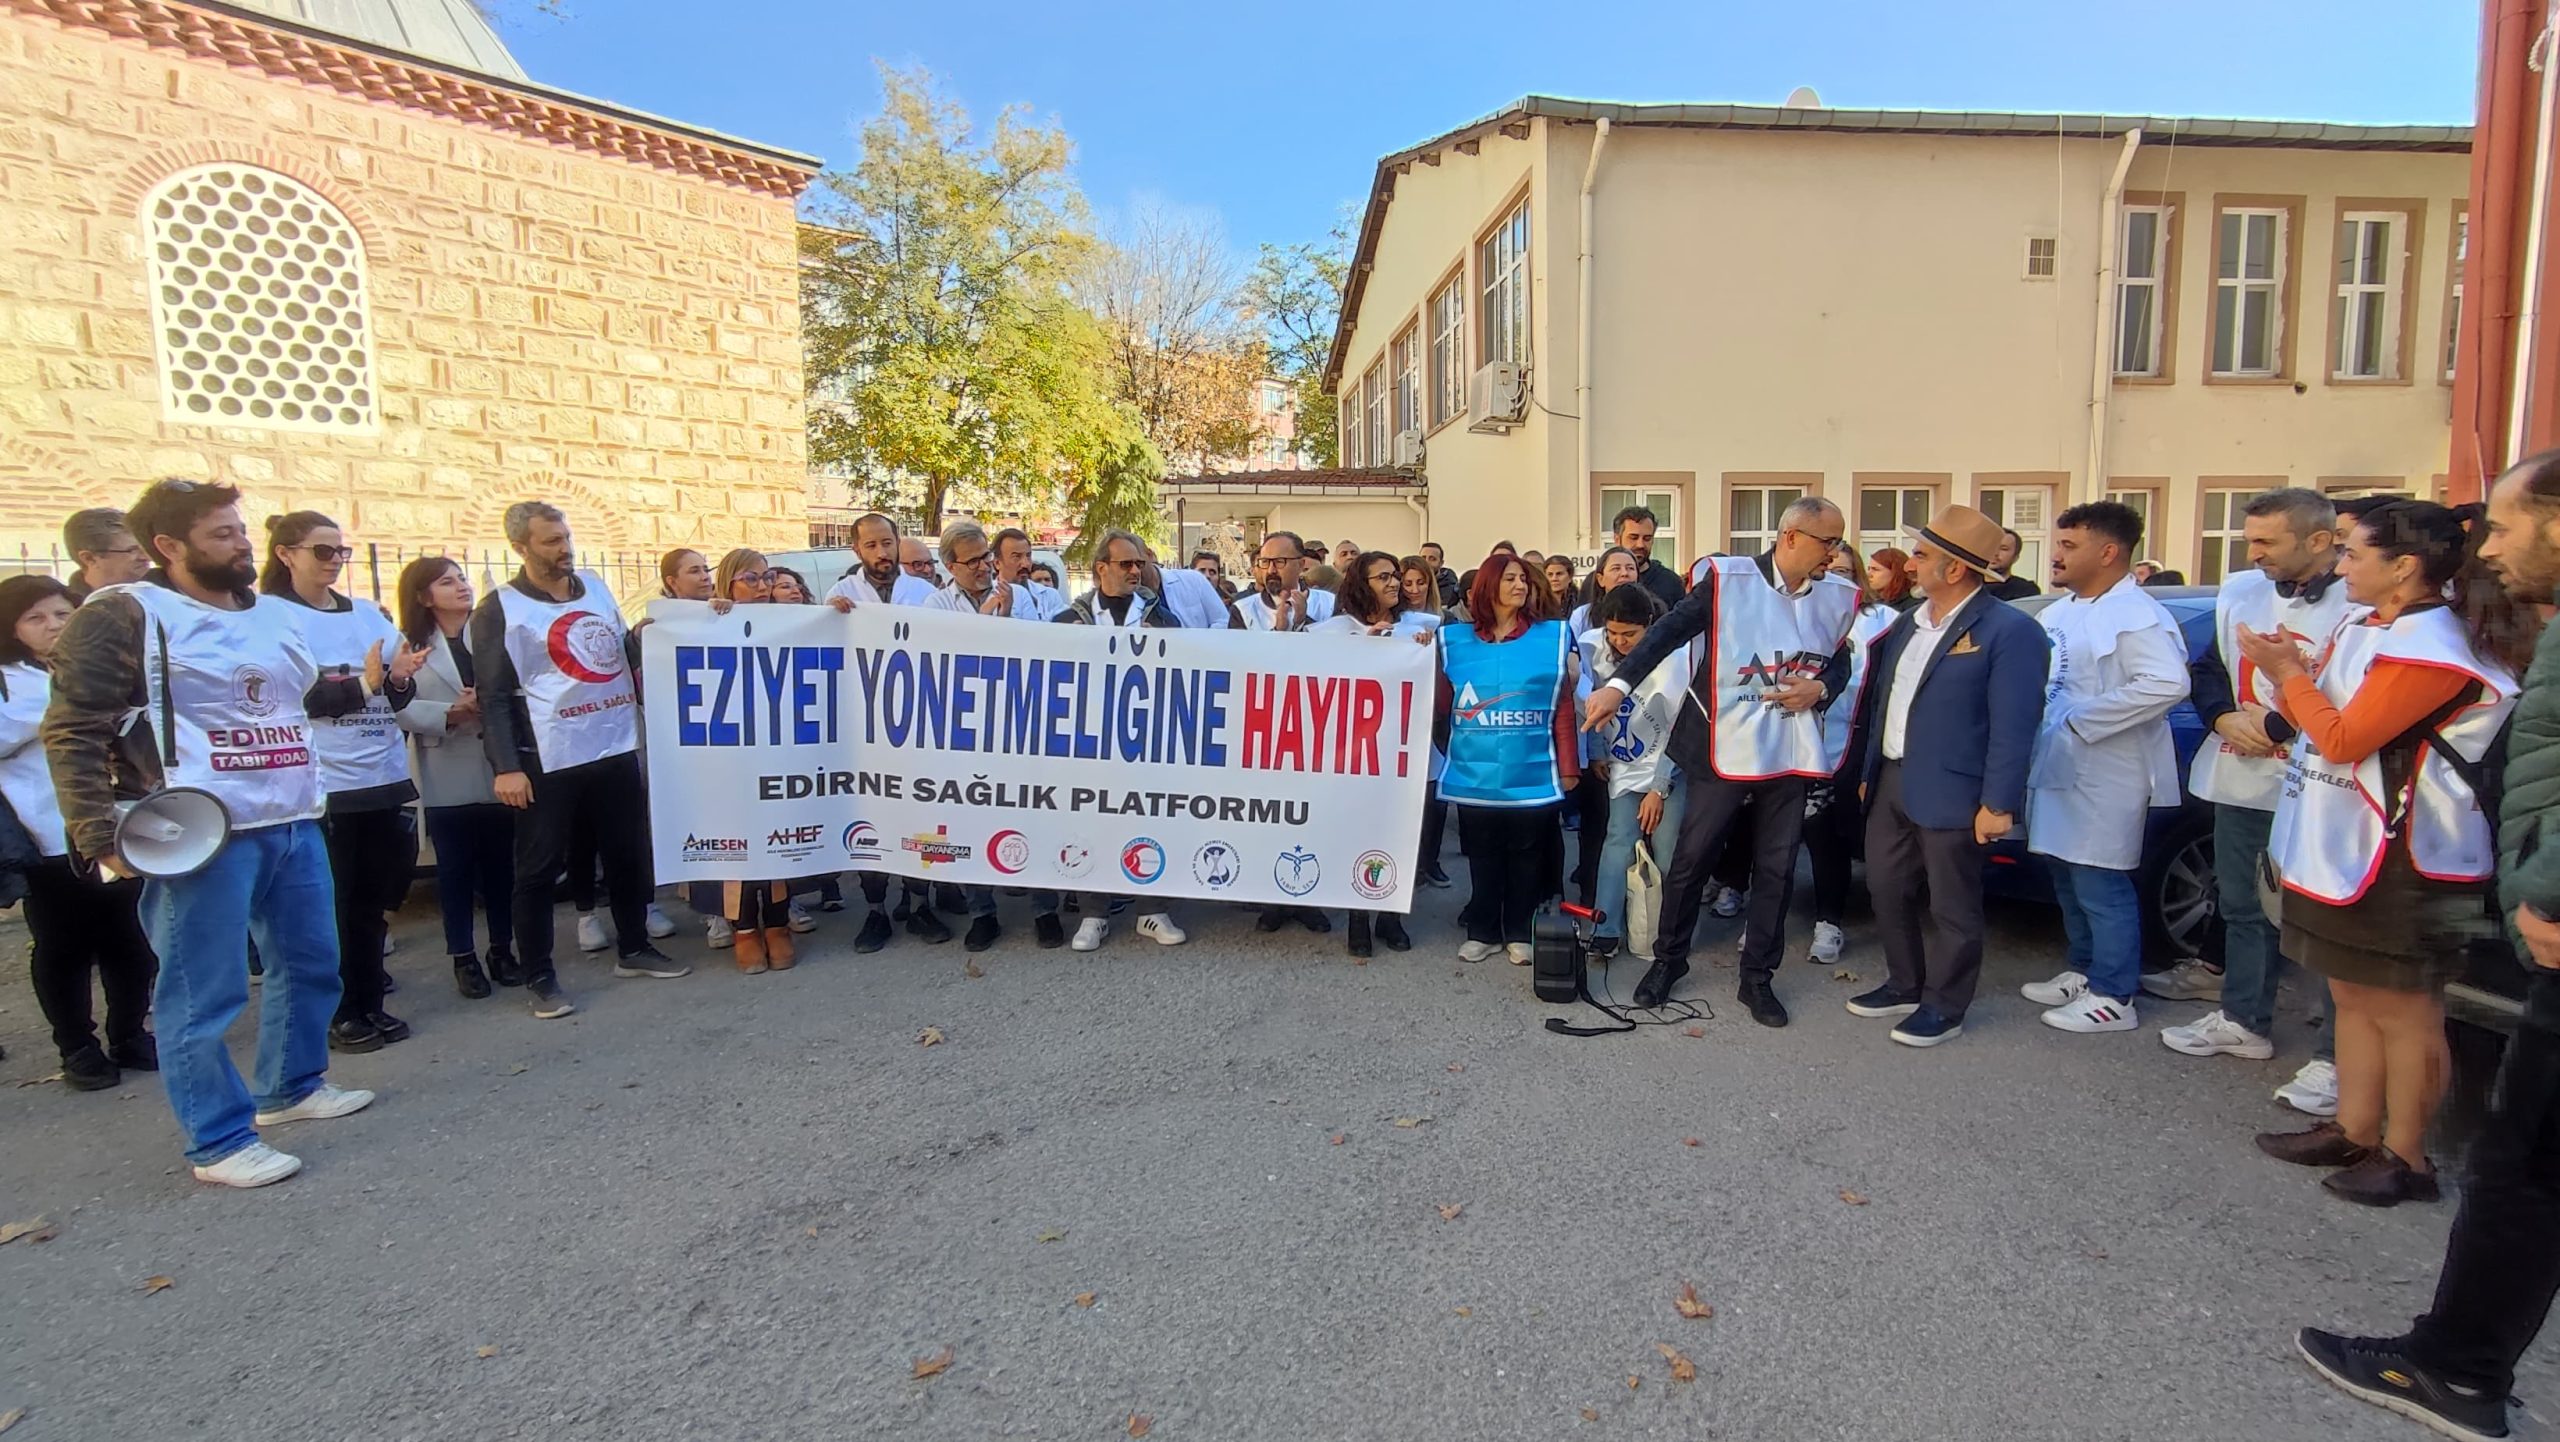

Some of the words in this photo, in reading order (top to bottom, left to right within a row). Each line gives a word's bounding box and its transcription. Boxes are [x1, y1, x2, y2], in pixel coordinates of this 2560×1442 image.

[1570, 556, 1600, 568] BLO
[675, 620, 845, 747] EZİYET
[856, 621, 1231, 767] YÖNETMELİĞİNE
[1241, 672, 1384, 777] HAYIR
[1396, 681, 1413, 778] !
[1455, 680, 1543, 726] AHESEN
[559, 704, 602, 719] GENEL
[332, 718, 396, 727] FEDERASYO
[207, 722, 304, 748] EDİRNE
[214, 752, 271, 768] TABİP
[758, 766, 903, 800] EDİRNE
[912, 774, 1057, 810] SAĞLIK
[1070, 787, 1310, 826] PLATFORMU
[682, 832, 748, 851] AHESEN
[767, 824, 825, 846] AHEF
